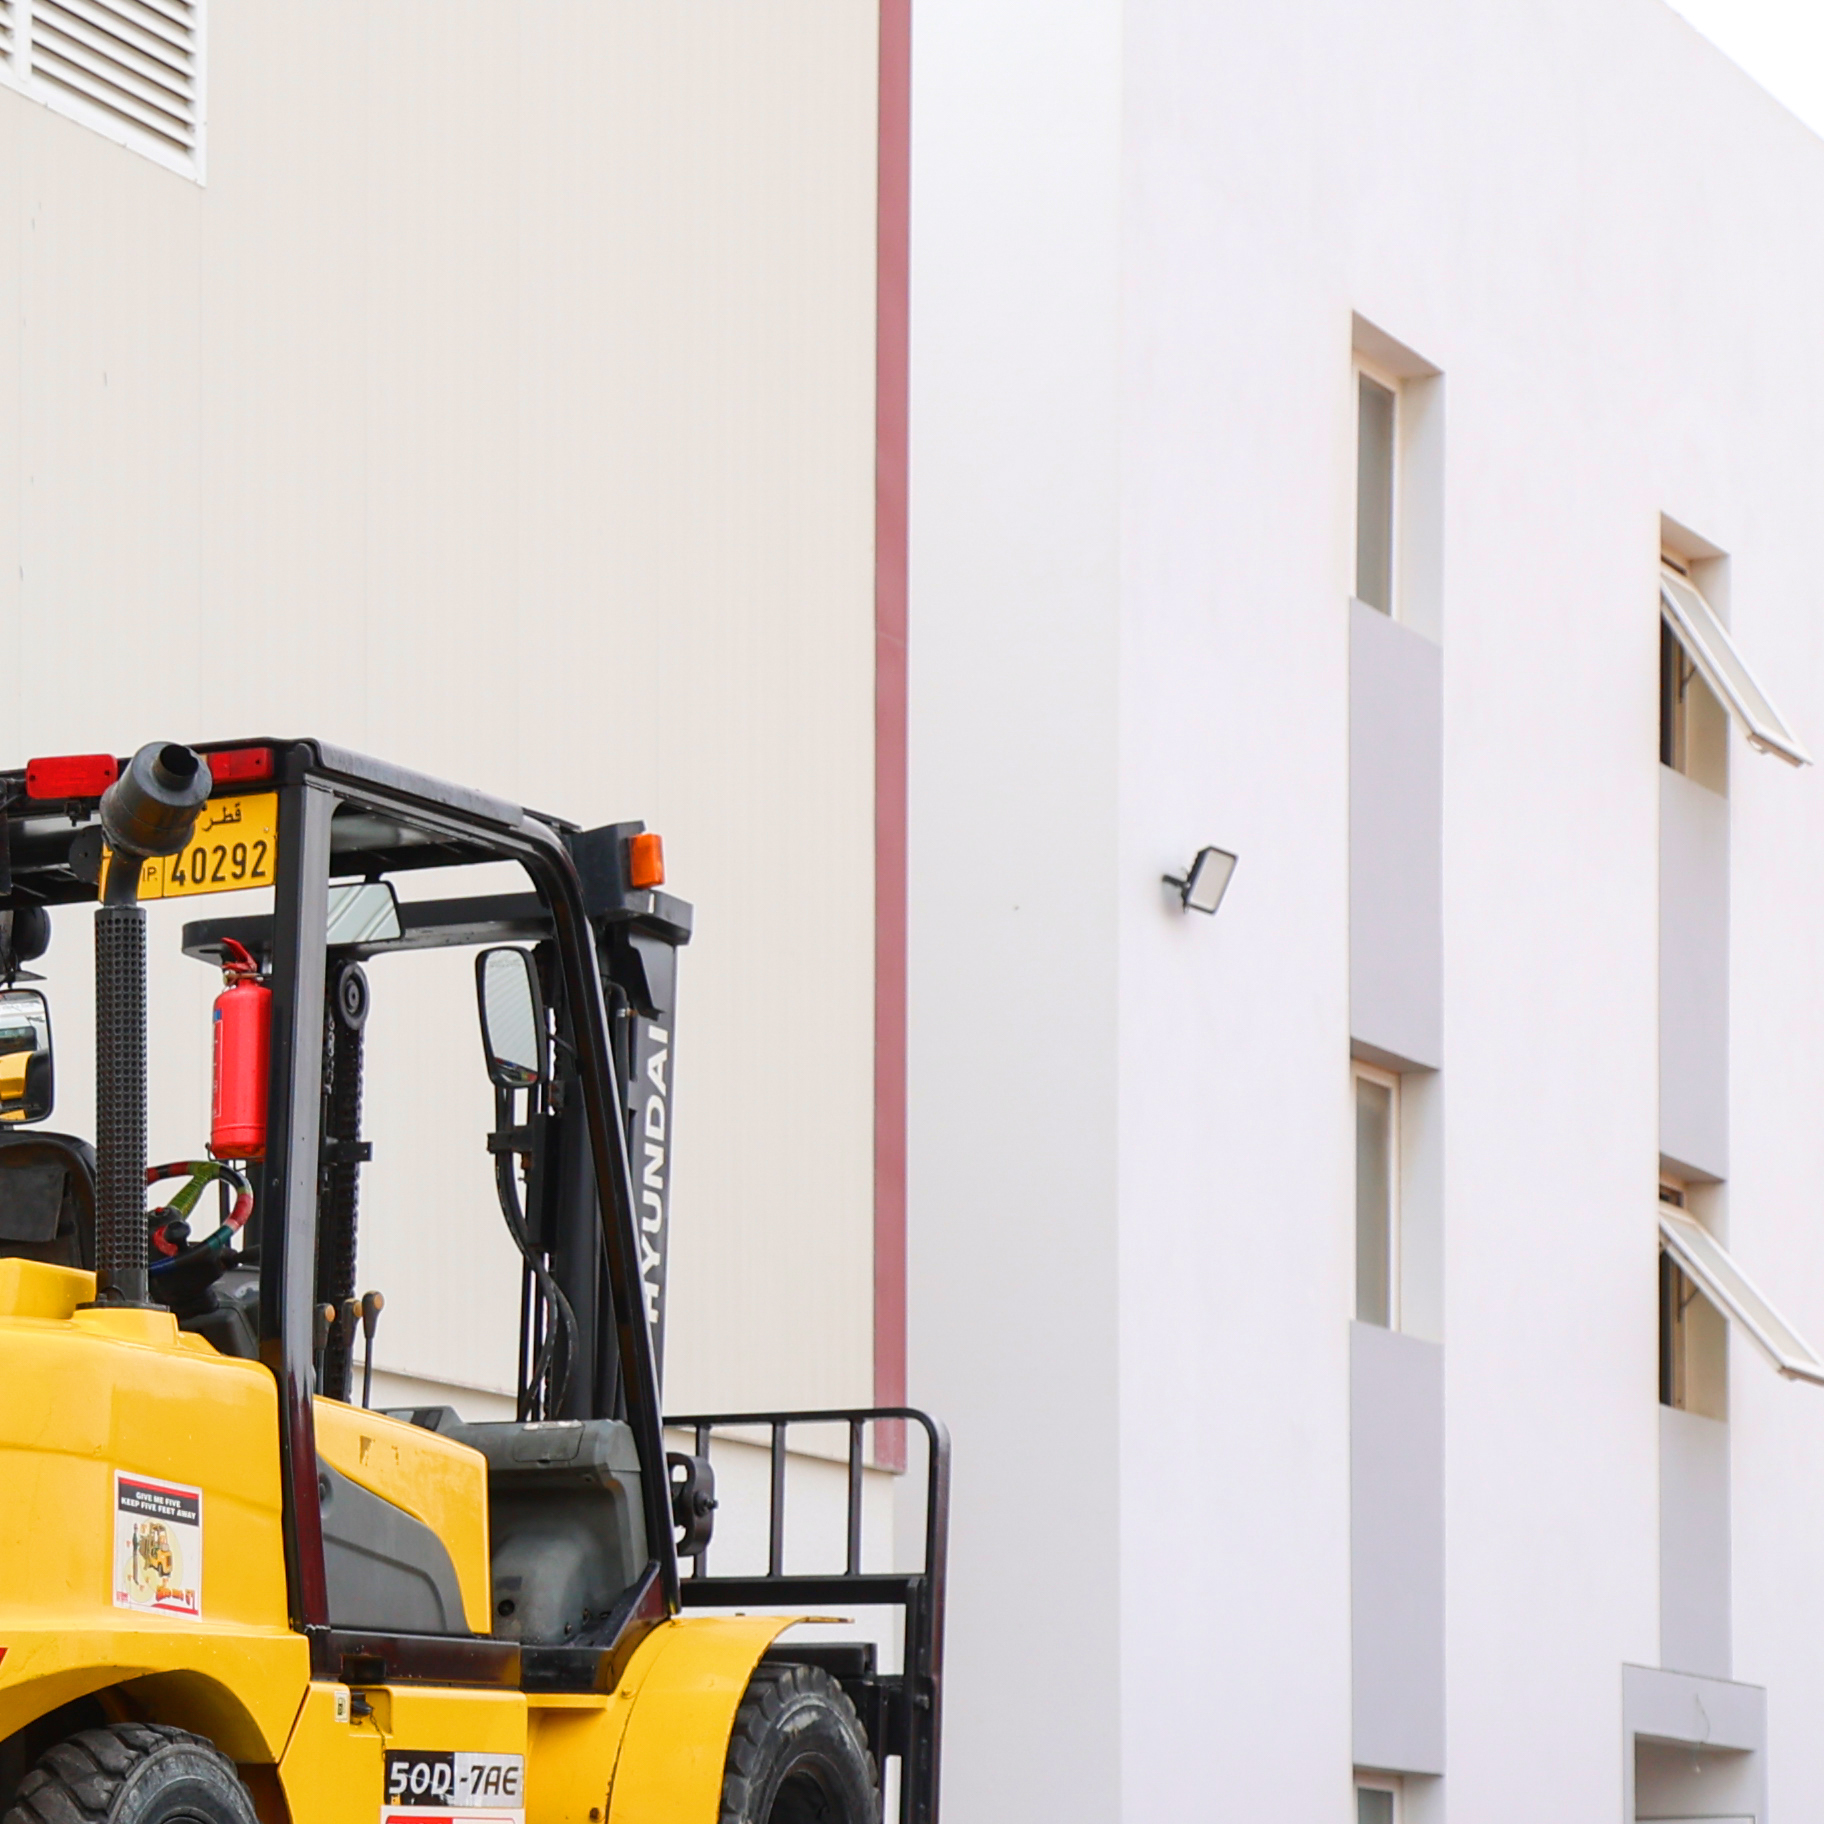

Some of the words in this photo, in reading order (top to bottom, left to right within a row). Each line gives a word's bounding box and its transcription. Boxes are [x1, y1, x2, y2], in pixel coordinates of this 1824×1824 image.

[202, 803, 242, 831] قطر
[171, 840, 268, 887] 40292
[641, 1025, 669, 1325] HYUNDAI
[121, 1497, 140, 1508] KEEP
[140, 1501, 157, 1512] FIVE
[157, 1505, 176, 1516] FEET
[176, 1508, 197, 1520] AWAY
[135, 1491, 153, 1502] GIVE
[153, 1495, 165, 1505] ME
[165, 1498, 181, 1508] FIVE
